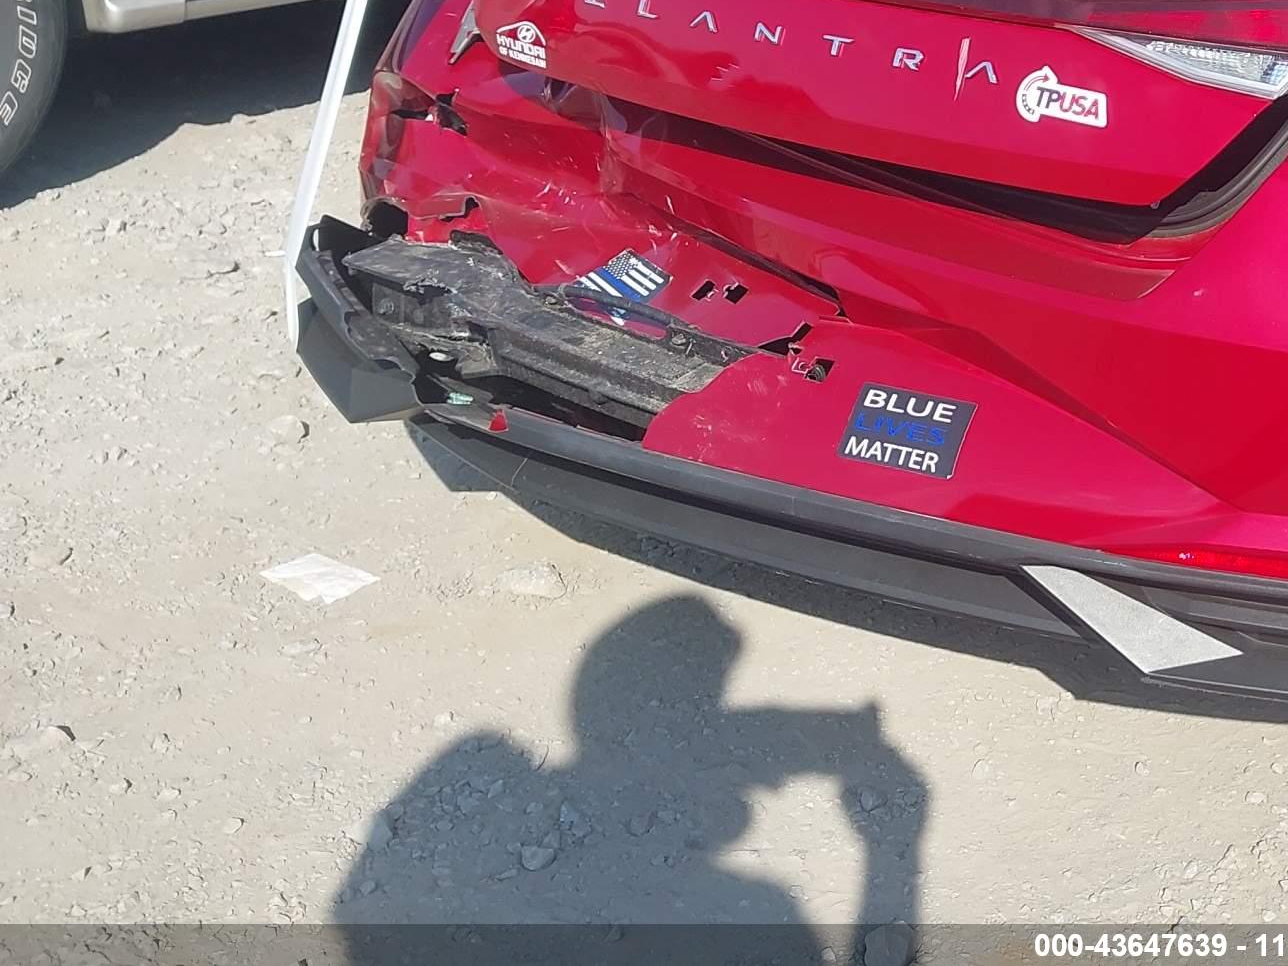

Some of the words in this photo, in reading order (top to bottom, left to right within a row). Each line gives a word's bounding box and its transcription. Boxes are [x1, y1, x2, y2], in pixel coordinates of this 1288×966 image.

[496, 34, 546, 59] HYUNDAI
[1036, 86, 1099, 120] TPUSA
[863, 388, 957, 423] BLUE
[854, 411, 948, 446] LIVES
[844, 436, 939, 473] MATTER
